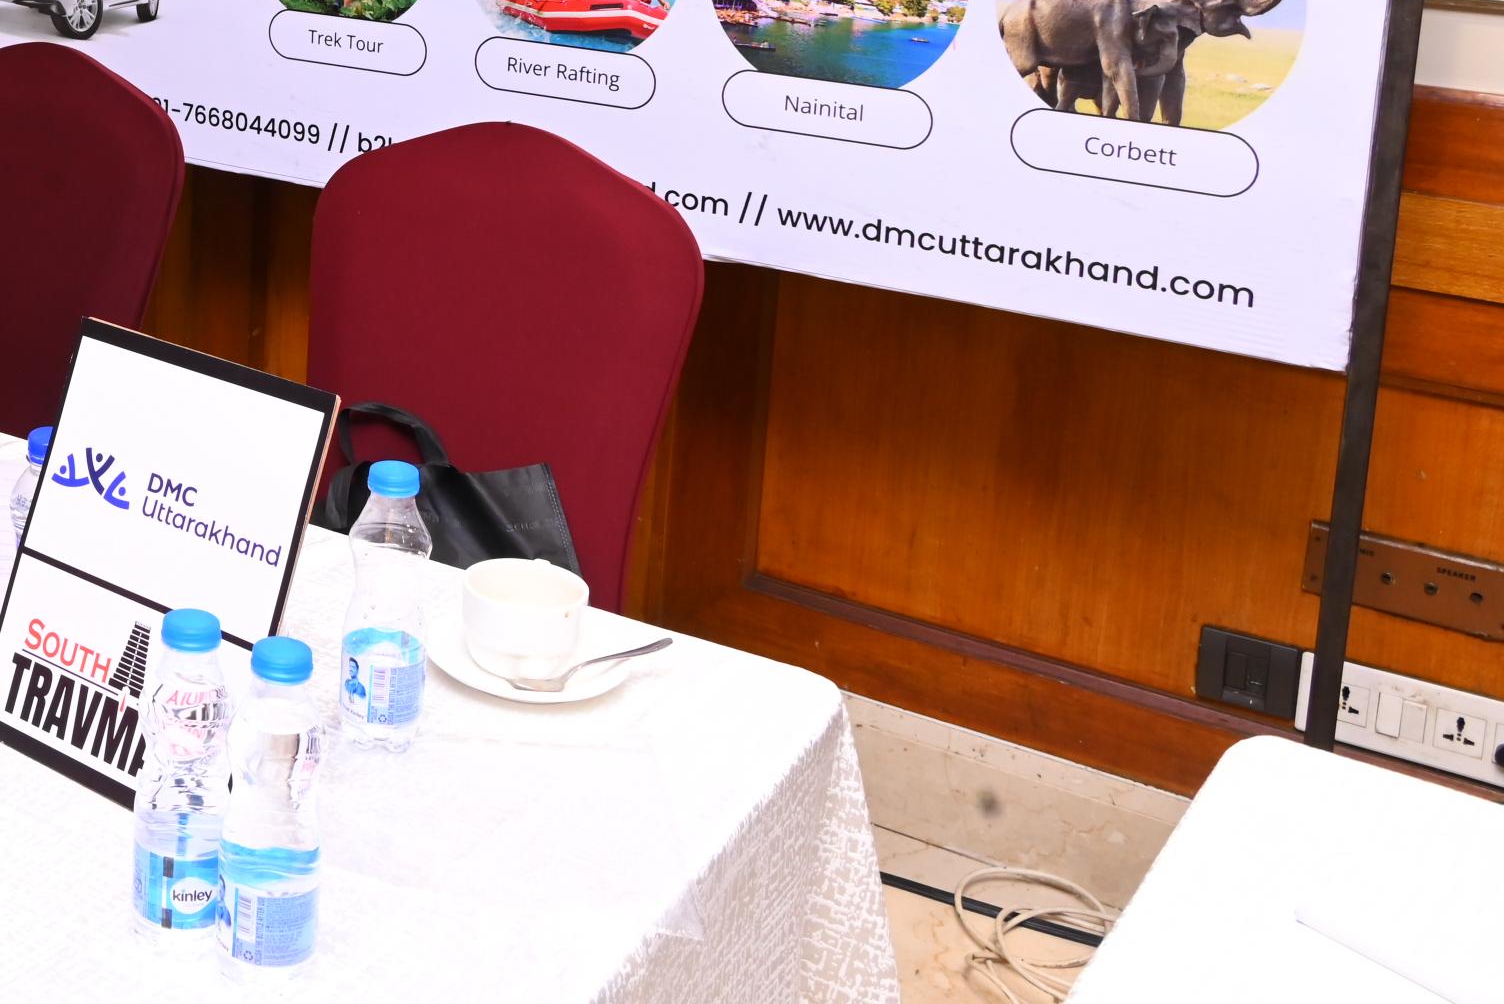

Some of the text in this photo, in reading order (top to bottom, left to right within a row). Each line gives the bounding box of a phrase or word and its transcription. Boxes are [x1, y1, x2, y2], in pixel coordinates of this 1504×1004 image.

[308, 28, 384, 54] Trek Tour
[506, 56, 621, 92] River Rafting
[153, 97, 320, 145] 1-7668044099
[784, 94, 864, 122] Nainital
[1084, 135, 1178, 167] Corbett
[777, 205, 1255, 308] www.dmcuttarakhand.com
[147, 472, 199, 507] DMC
[141, 496, 282, 567] Uttarakhand
[1436, 566, 1477, 582] SPEAKER
[24, 618, 112, 684] SOUTH
[172, 889, 213, 903] kinley
